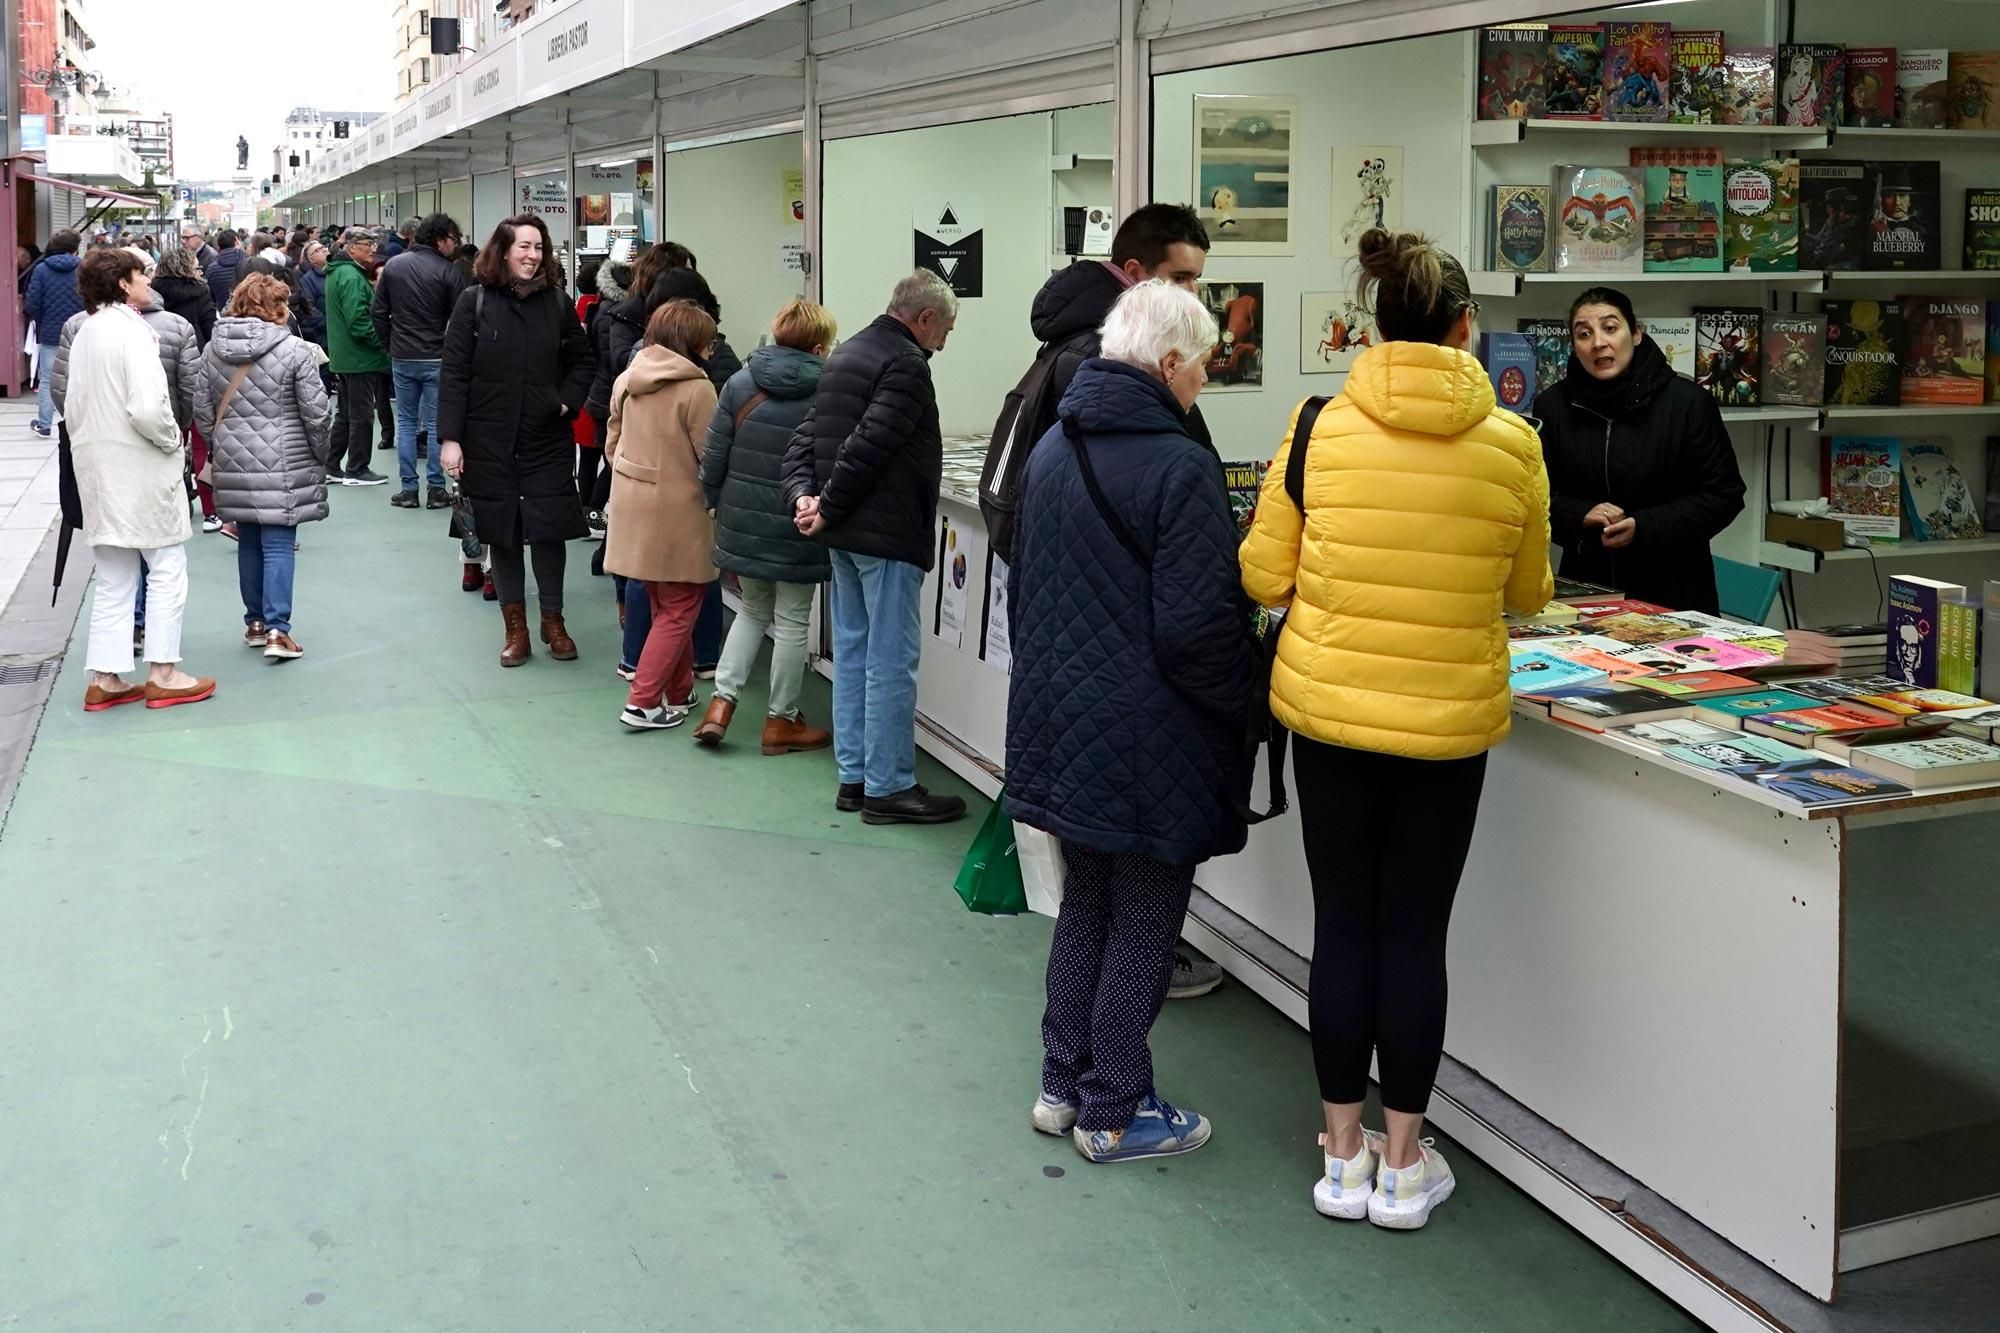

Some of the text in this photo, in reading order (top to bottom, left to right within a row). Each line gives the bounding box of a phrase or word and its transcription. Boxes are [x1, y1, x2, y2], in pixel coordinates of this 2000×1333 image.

[1610, 24, 1628, 34] Los
[1631, 24, 1664, 34] Cutro
[547, 21, 588, 62] LIBRERÍA PASTOR
[1488, 30, 1544, 42] CIVIL WAR II
[1552, 32, 1593, 44] IMPERIO
[1802, 46, 1839, 56] Placer
[1678, 54, 1720, 67] SIMIOS
[1638, 152, 1717, 160] CUENTOS DE TEMPORADA
[1800, 167, 1849, 177] BLUEBERRY
[180, 190, 189, 200] P
[1728, 187, 1769, 200] MITOLOGÍA
[522, 205, 542, 213] 10%
[1970, 206, 2000, 222] SHO
[1504, 226, 1542, 239] Harry Potter
[1876, 231, 1921, 241] MARSHAL
[1872, 242, 1926, 253] BLUEBERRY
[1929, 303, 1980, 314] DJANGO
[1650, 324, 1690, 336] Principito
[1772, 323, 1817, 334] CONAN
[1825, 346, 1898, 365] CONQUISTADOR
[1238, 471, 1256, 488] MAN
[1903, 601, 1923, 613] Asimov
